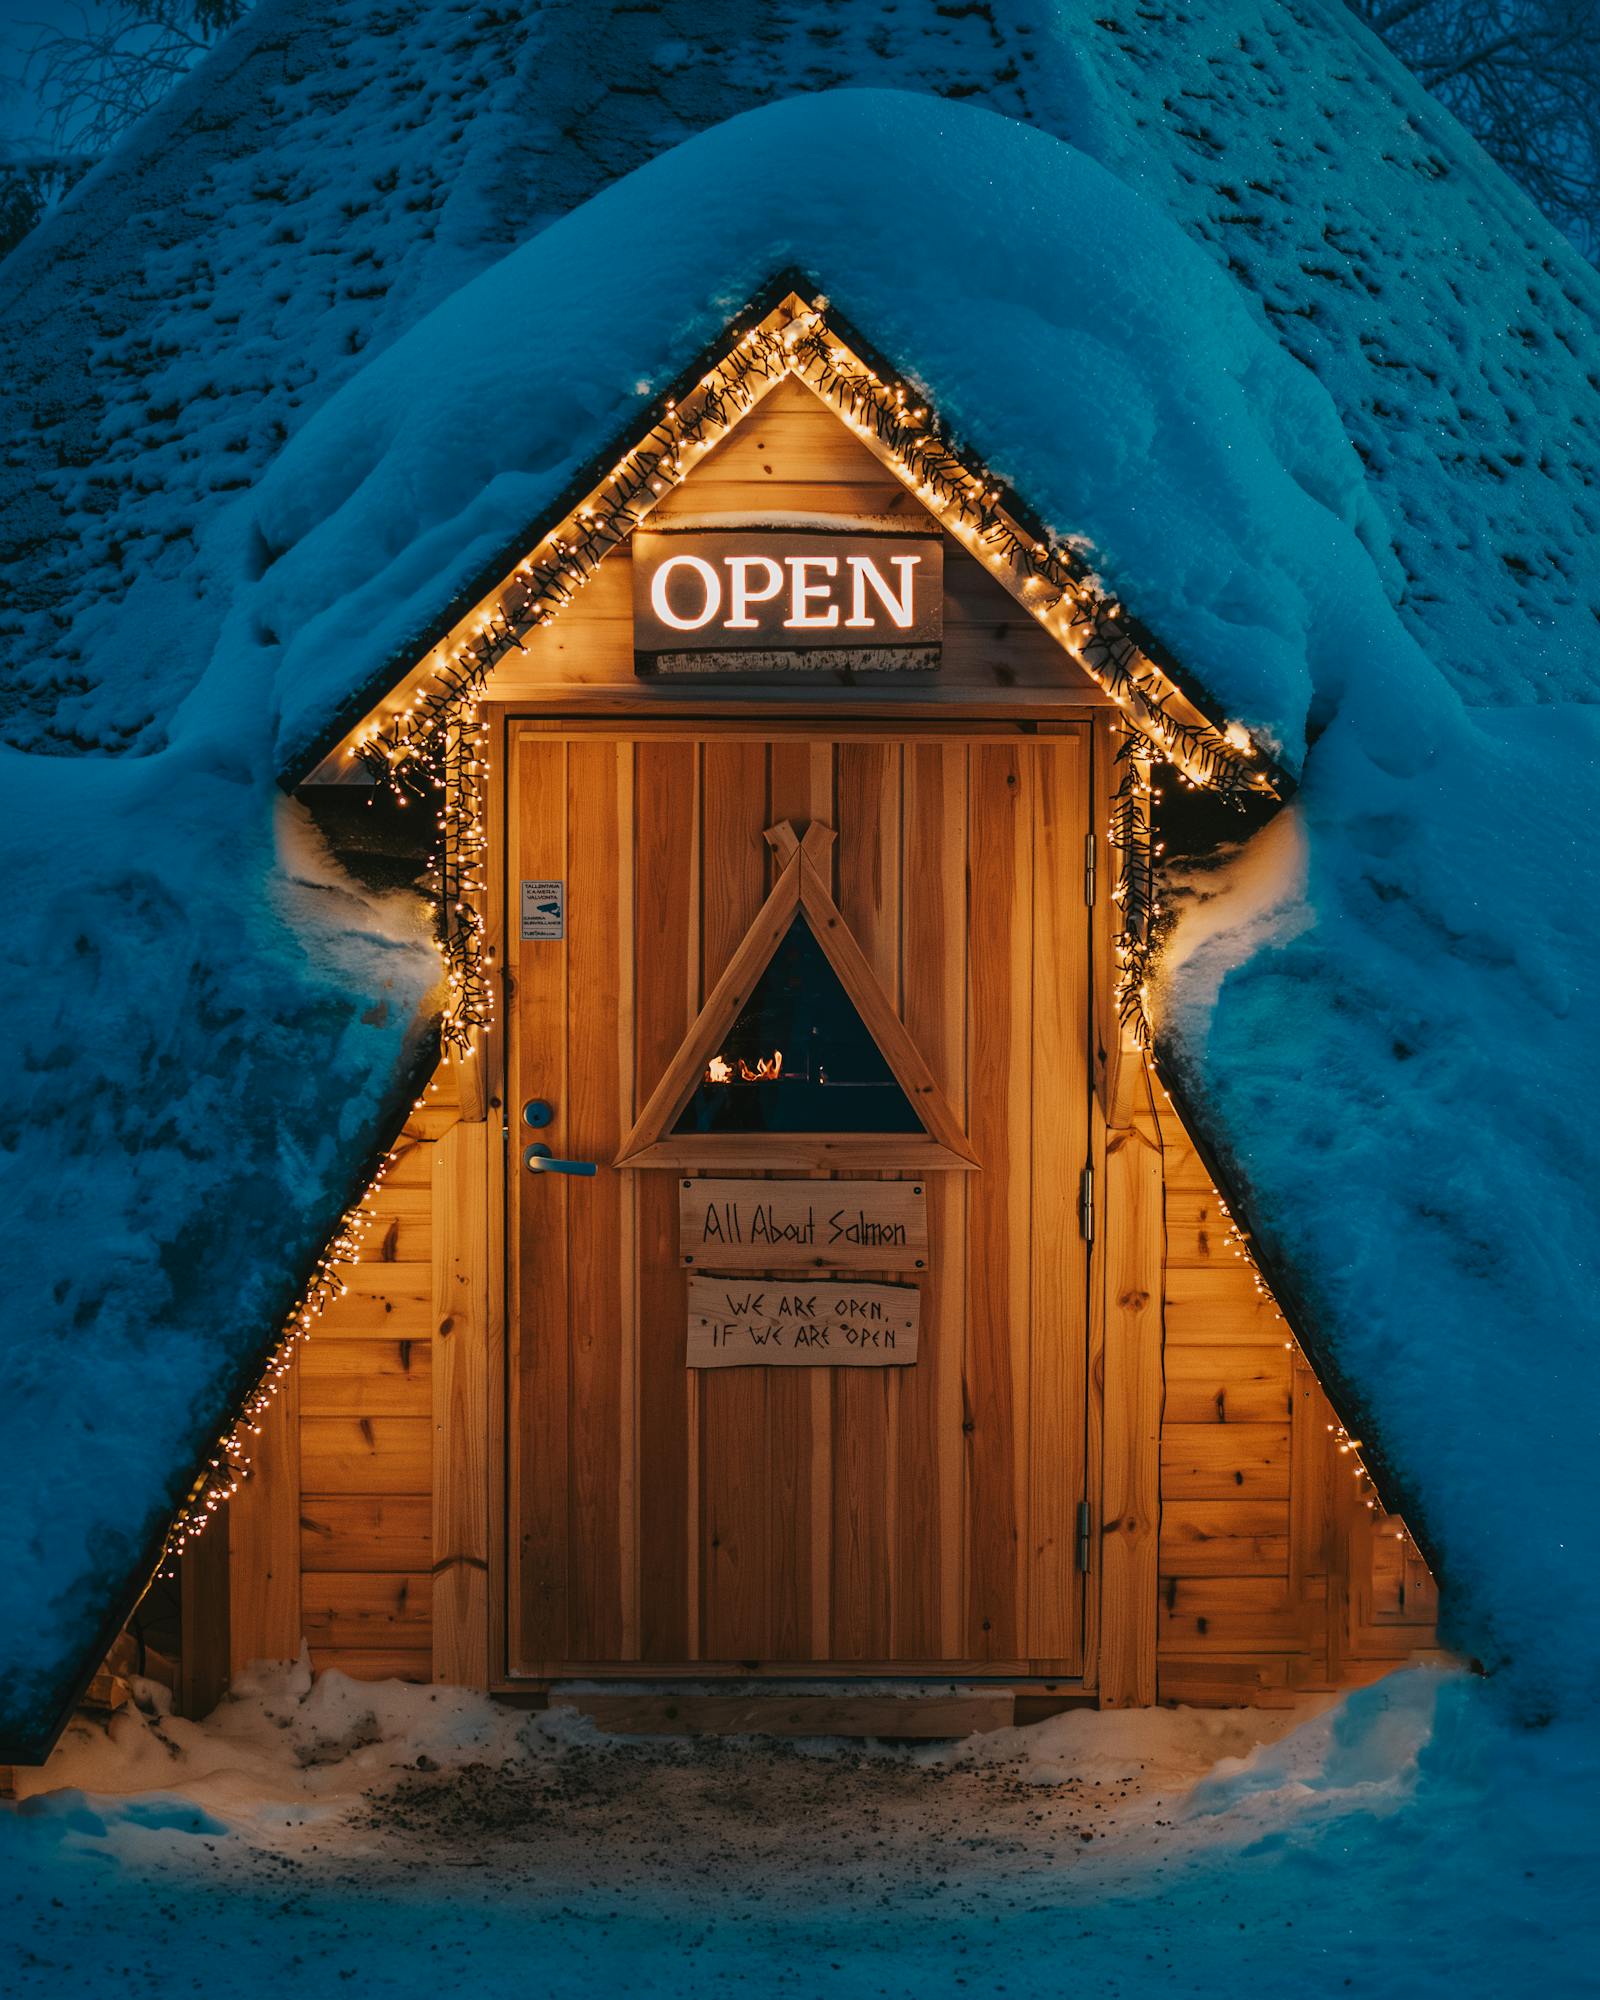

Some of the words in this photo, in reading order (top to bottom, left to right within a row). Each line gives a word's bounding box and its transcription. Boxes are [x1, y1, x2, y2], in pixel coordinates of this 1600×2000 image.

[650, 554, 922, 630] OPEN
[702, 1202, 742, 1243] All
[750, 1204, 816, 1245] About
[828, 1209, 907, 1246] Salmon
[726, 1293, 765, 1316] WE
[779, 1295, 817, 1318] ARE
[834, 1298, 889, 1322] OPEN,
[713, 1323, 738, 1347] IF
[749, 1325, 784, 1346] WE
[794, 1324, 830, 1349] ARE
[845, 1327, 896, 1349] OPEN
